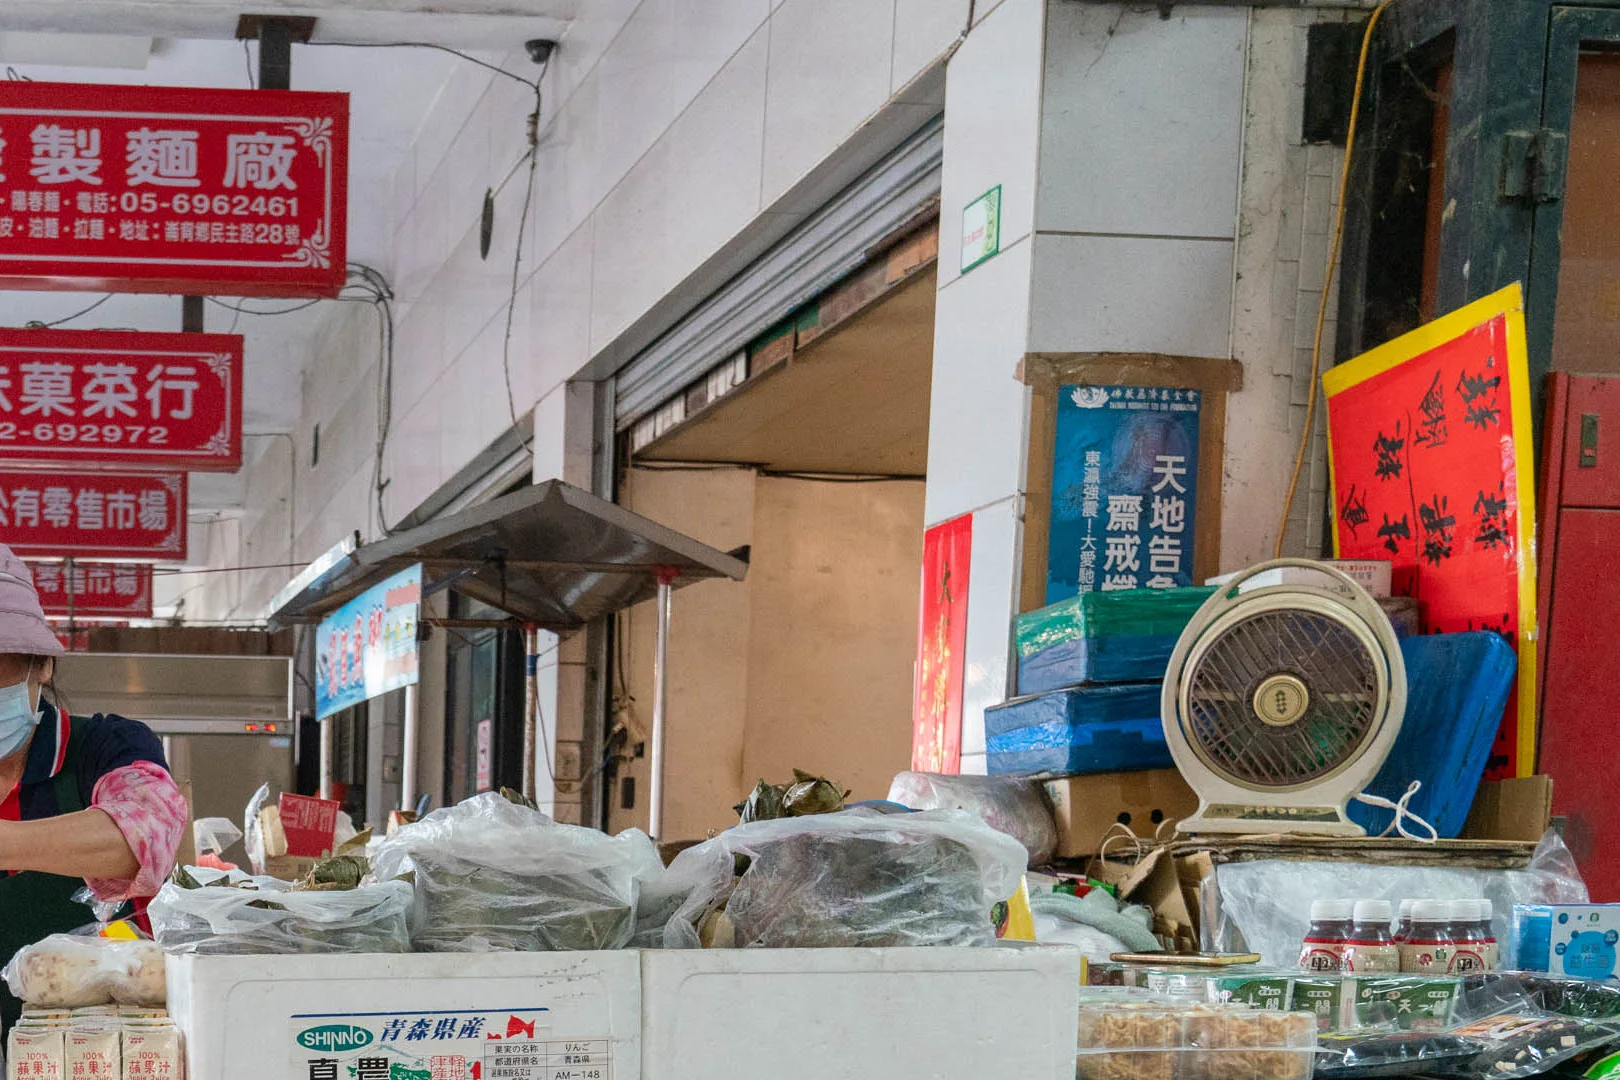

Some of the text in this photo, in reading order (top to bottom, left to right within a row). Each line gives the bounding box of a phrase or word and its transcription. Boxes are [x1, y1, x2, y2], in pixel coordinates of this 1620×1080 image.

[380, 1017, 486, 1041] 青森県産
[304, 1027, 367, 1047] SHINNO
[495, 1042, 590, 1054] 果実の名称 りんご
[27, 1052, 48, 1060] 100%
[83, 1052, 104, 1060] 100%
[139, 1051, 160, 1059] 100%
[495, 1055, 590, 1066] 都道府県名 青森県
[17, 1061, 59, 1075] 蘋果汁
[73, 1061, 113, 1075] 蘋果汁
[129, 1060, 170, 1074] 蘋果汁
